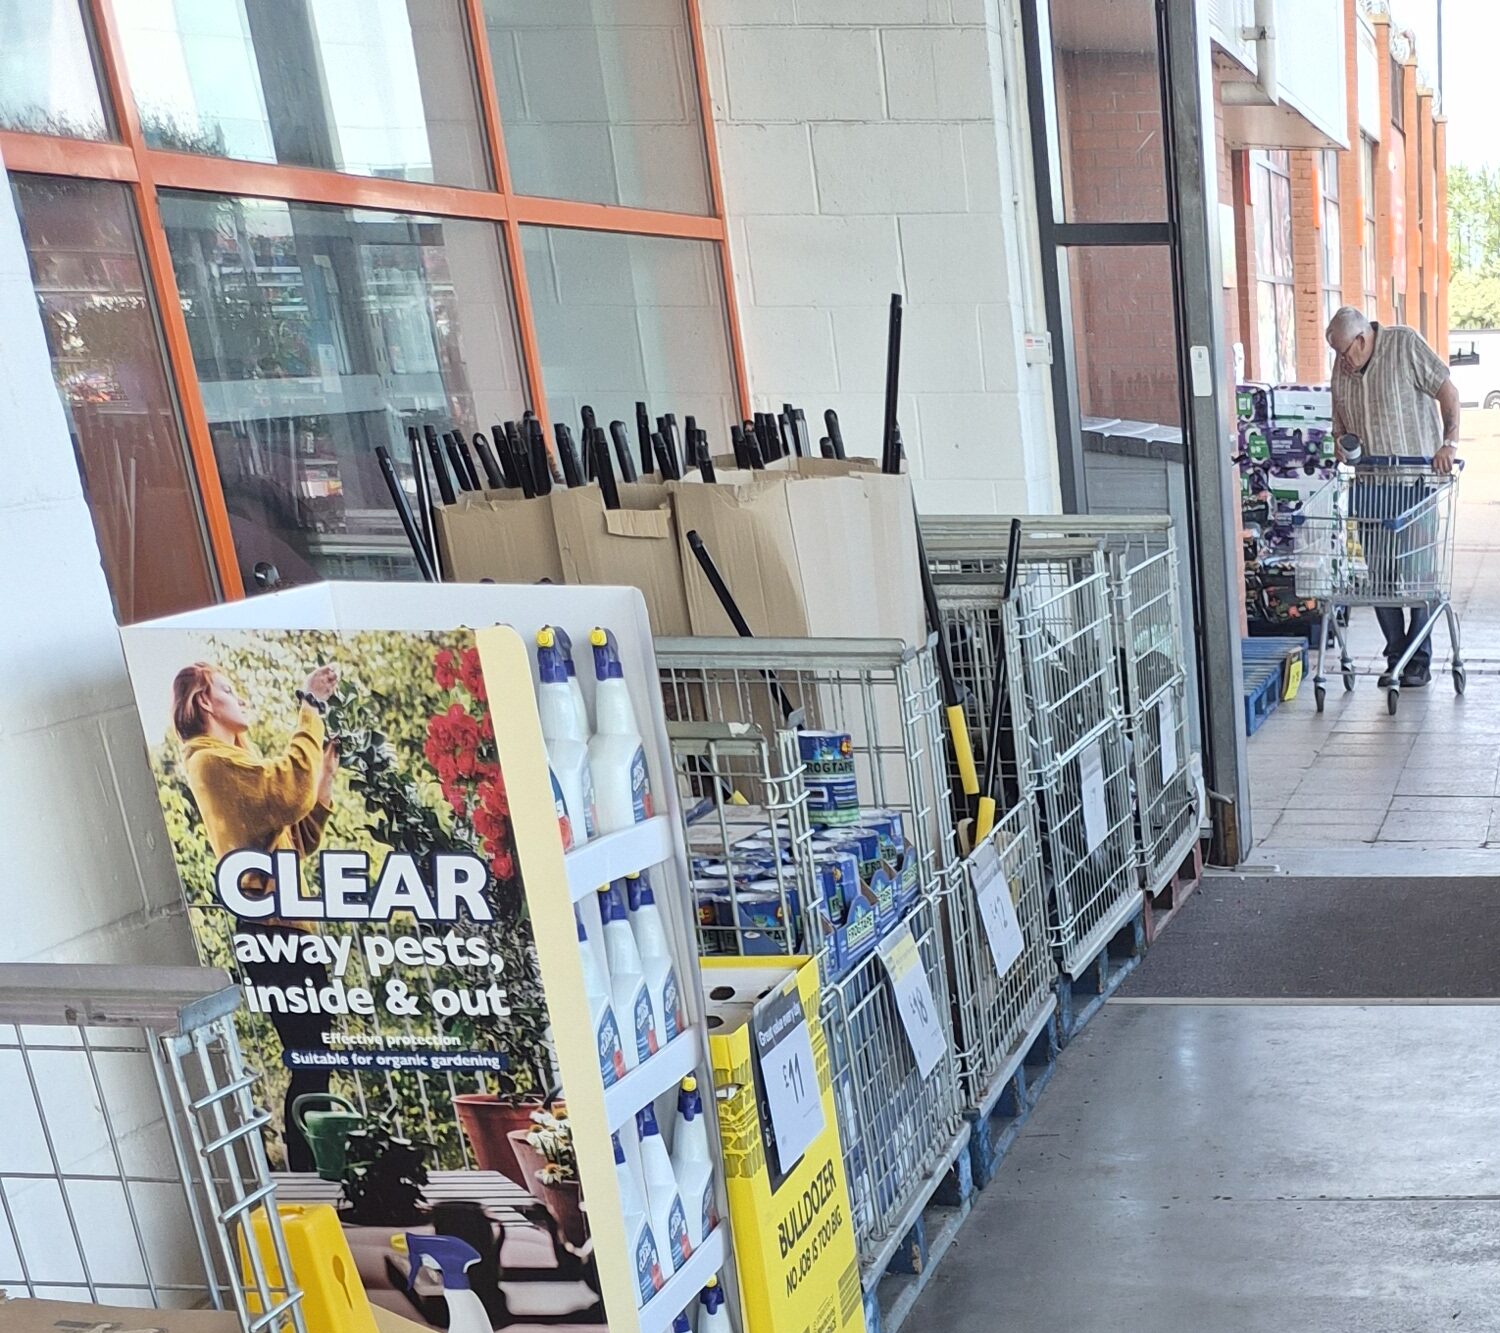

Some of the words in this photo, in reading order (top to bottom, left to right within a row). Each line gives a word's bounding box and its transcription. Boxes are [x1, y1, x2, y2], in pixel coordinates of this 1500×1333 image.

[217, 849, 495, 922] CLEAR
[235, 932, 352, 977] away
[363, 930, 504, 977] pests,
[244, 977, 376, 1016] inside
[385, 980, 422, 1016] &
[432, 983, 512, 1017] out
[291, 1052, 349, 1067] Suitable
[351, 1054, 373, 1066] for
[376, 1056, 429, 1070] organic
[431, 1055, 501, 1071] gardening
[321, 1033, 385, 1048] Effective
[387, 1034, 461, 1048] protection
[782, 1052, 805, 1104] £11
[778, 1158, 837, 1260] BULLDOZER
[786, 1266, 798, 1298] NO
[798, 1248, 812, 1283] JOB
[811, 1236, 818, 1264] IS
[818, 1225, 831, 1257] TOO
[830, 1204, 843, 1238] BIG
